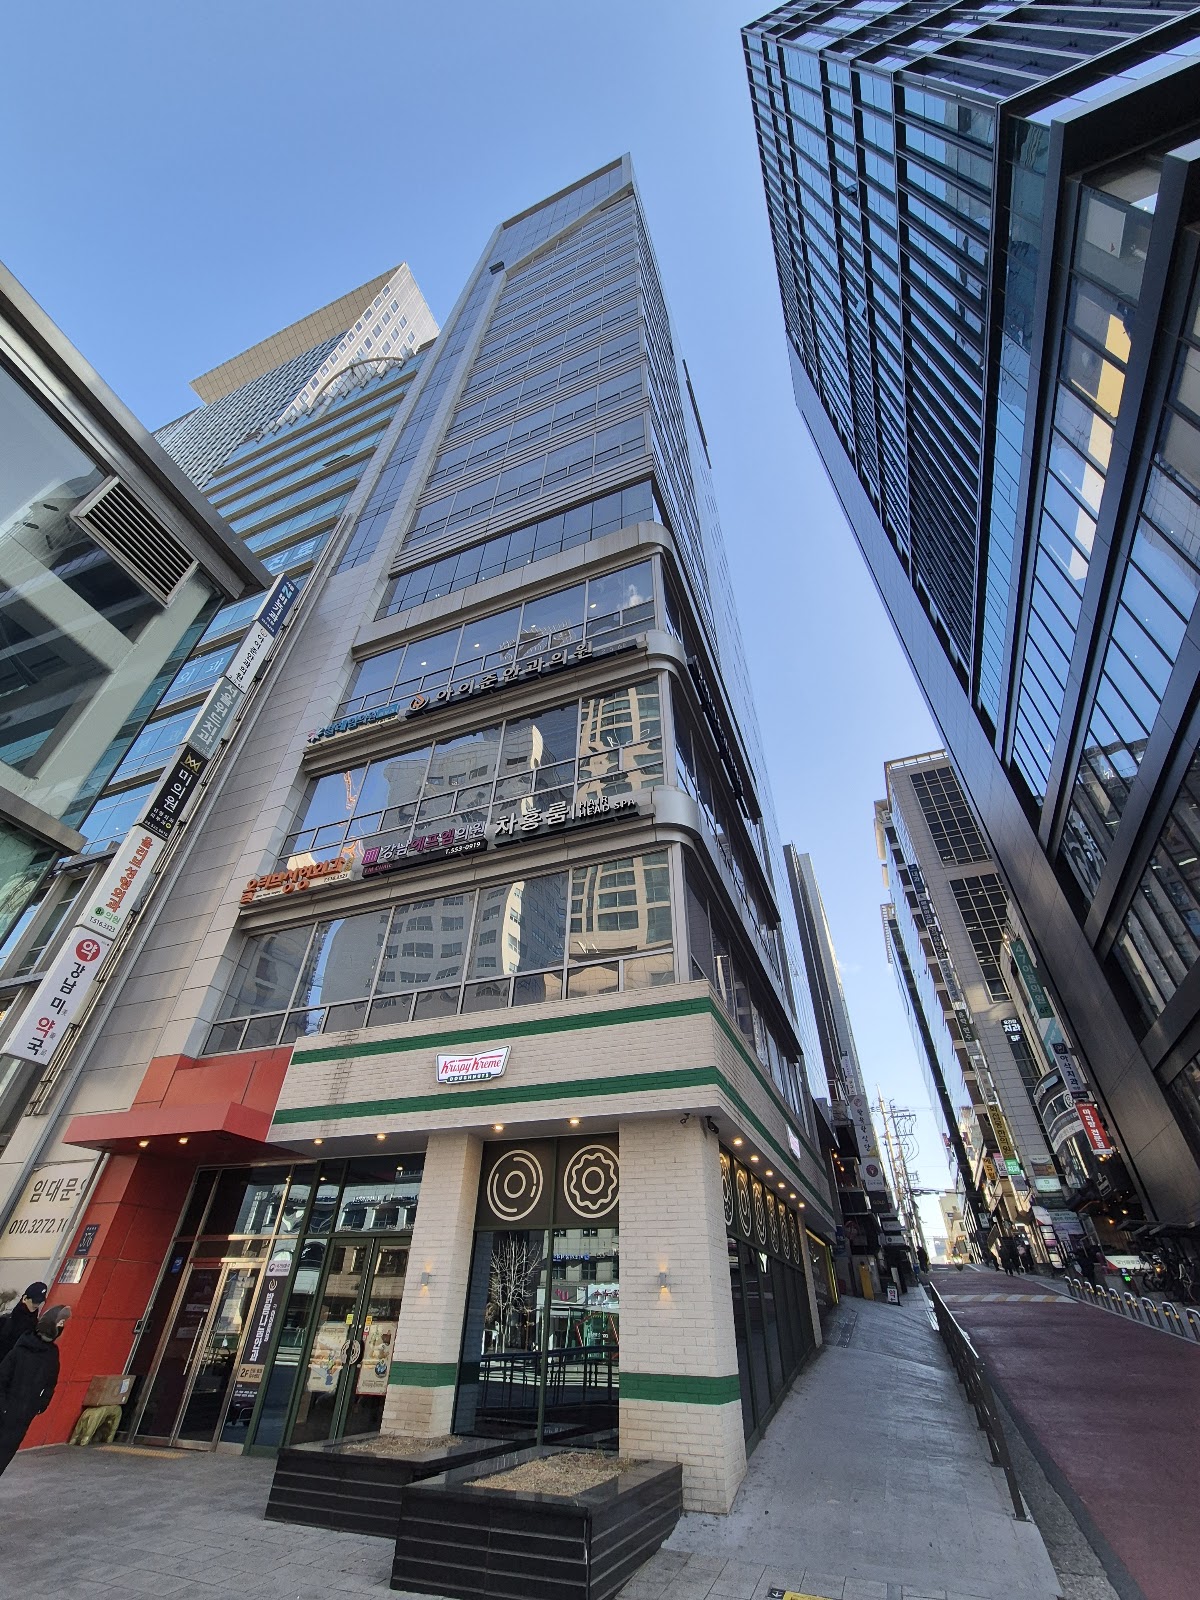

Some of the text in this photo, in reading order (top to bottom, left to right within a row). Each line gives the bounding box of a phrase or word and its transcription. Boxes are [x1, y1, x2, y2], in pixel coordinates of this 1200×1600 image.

[436, 641, 593, 701] 아이준안과의원
[197, 684, 238, 745] 서울위드치과
[164, 769, 193, 813] 미의원
[579, 796, 609, 808] HAIR
[495, 800, 570, 835] 차홍룸
[579, 799, 635, 818] HEAD SPA
[105, 836, 153, 913] 올리브성형외과
[239, 857, 346, 905] 올리브성형외과
[80, 941, 95, 961] 약
[1003, 1024, 1021, 1032] 치과
[441, 1055, 504, 1074] Krispy Kreme
[449, 1072, 490, 1083] DOUGHNUTS
